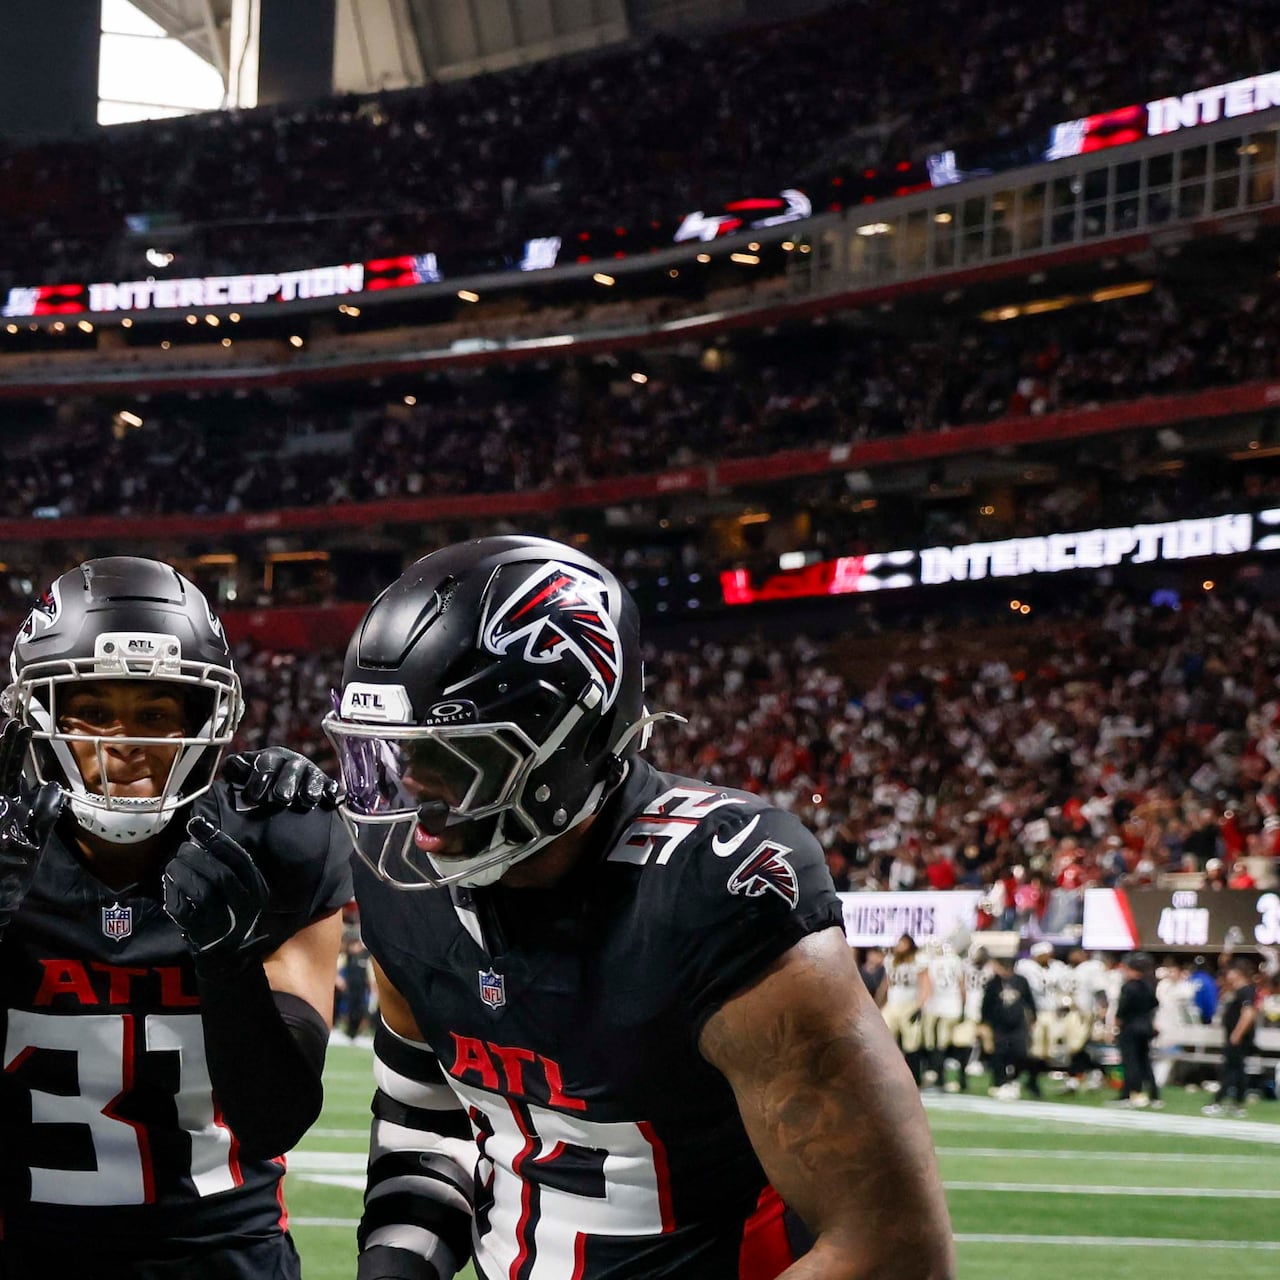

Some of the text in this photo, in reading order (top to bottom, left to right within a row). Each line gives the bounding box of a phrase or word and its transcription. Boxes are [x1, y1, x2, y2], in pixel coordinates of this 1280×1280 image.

[88, 264, 365, 312] INTERCEPTION
[919, 513, 1256, 586] INTERCEPTION
[128, 639, 155, 651] ATL
[351, 693, 384, 709] ATL
[426, 711, 473, 726] OAKLEY
[33, 959, 200, 1005] ATL
[448, 1031, 587, 1111] ATL
[5, 1008, 244, 1206] 31
